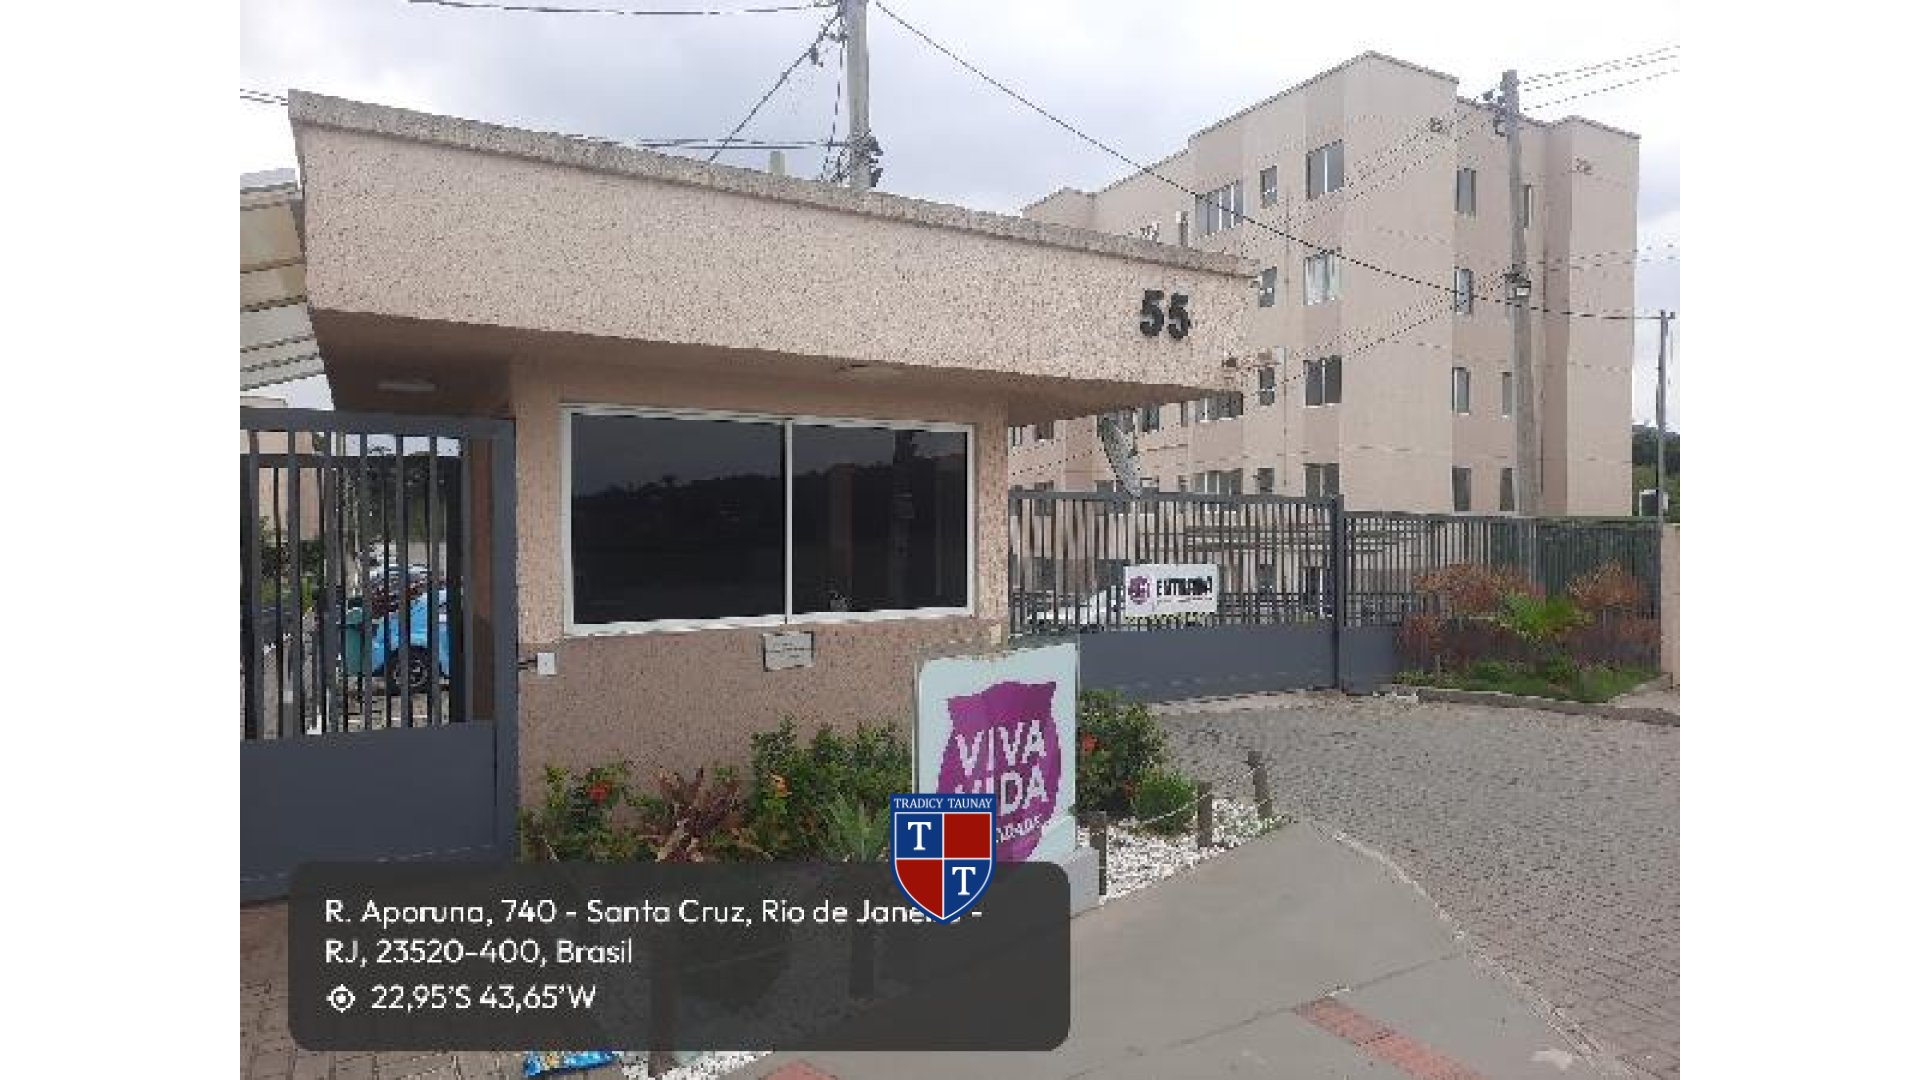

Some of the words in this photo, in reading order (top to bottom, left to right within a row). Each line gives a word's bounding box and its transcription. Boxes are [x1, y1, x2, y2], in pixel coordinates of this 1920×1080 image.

[1140, 289, 1190, 341] 55
[955, 719, 1047, 776] VIVA
[954, 764, 1049, 816] DA
